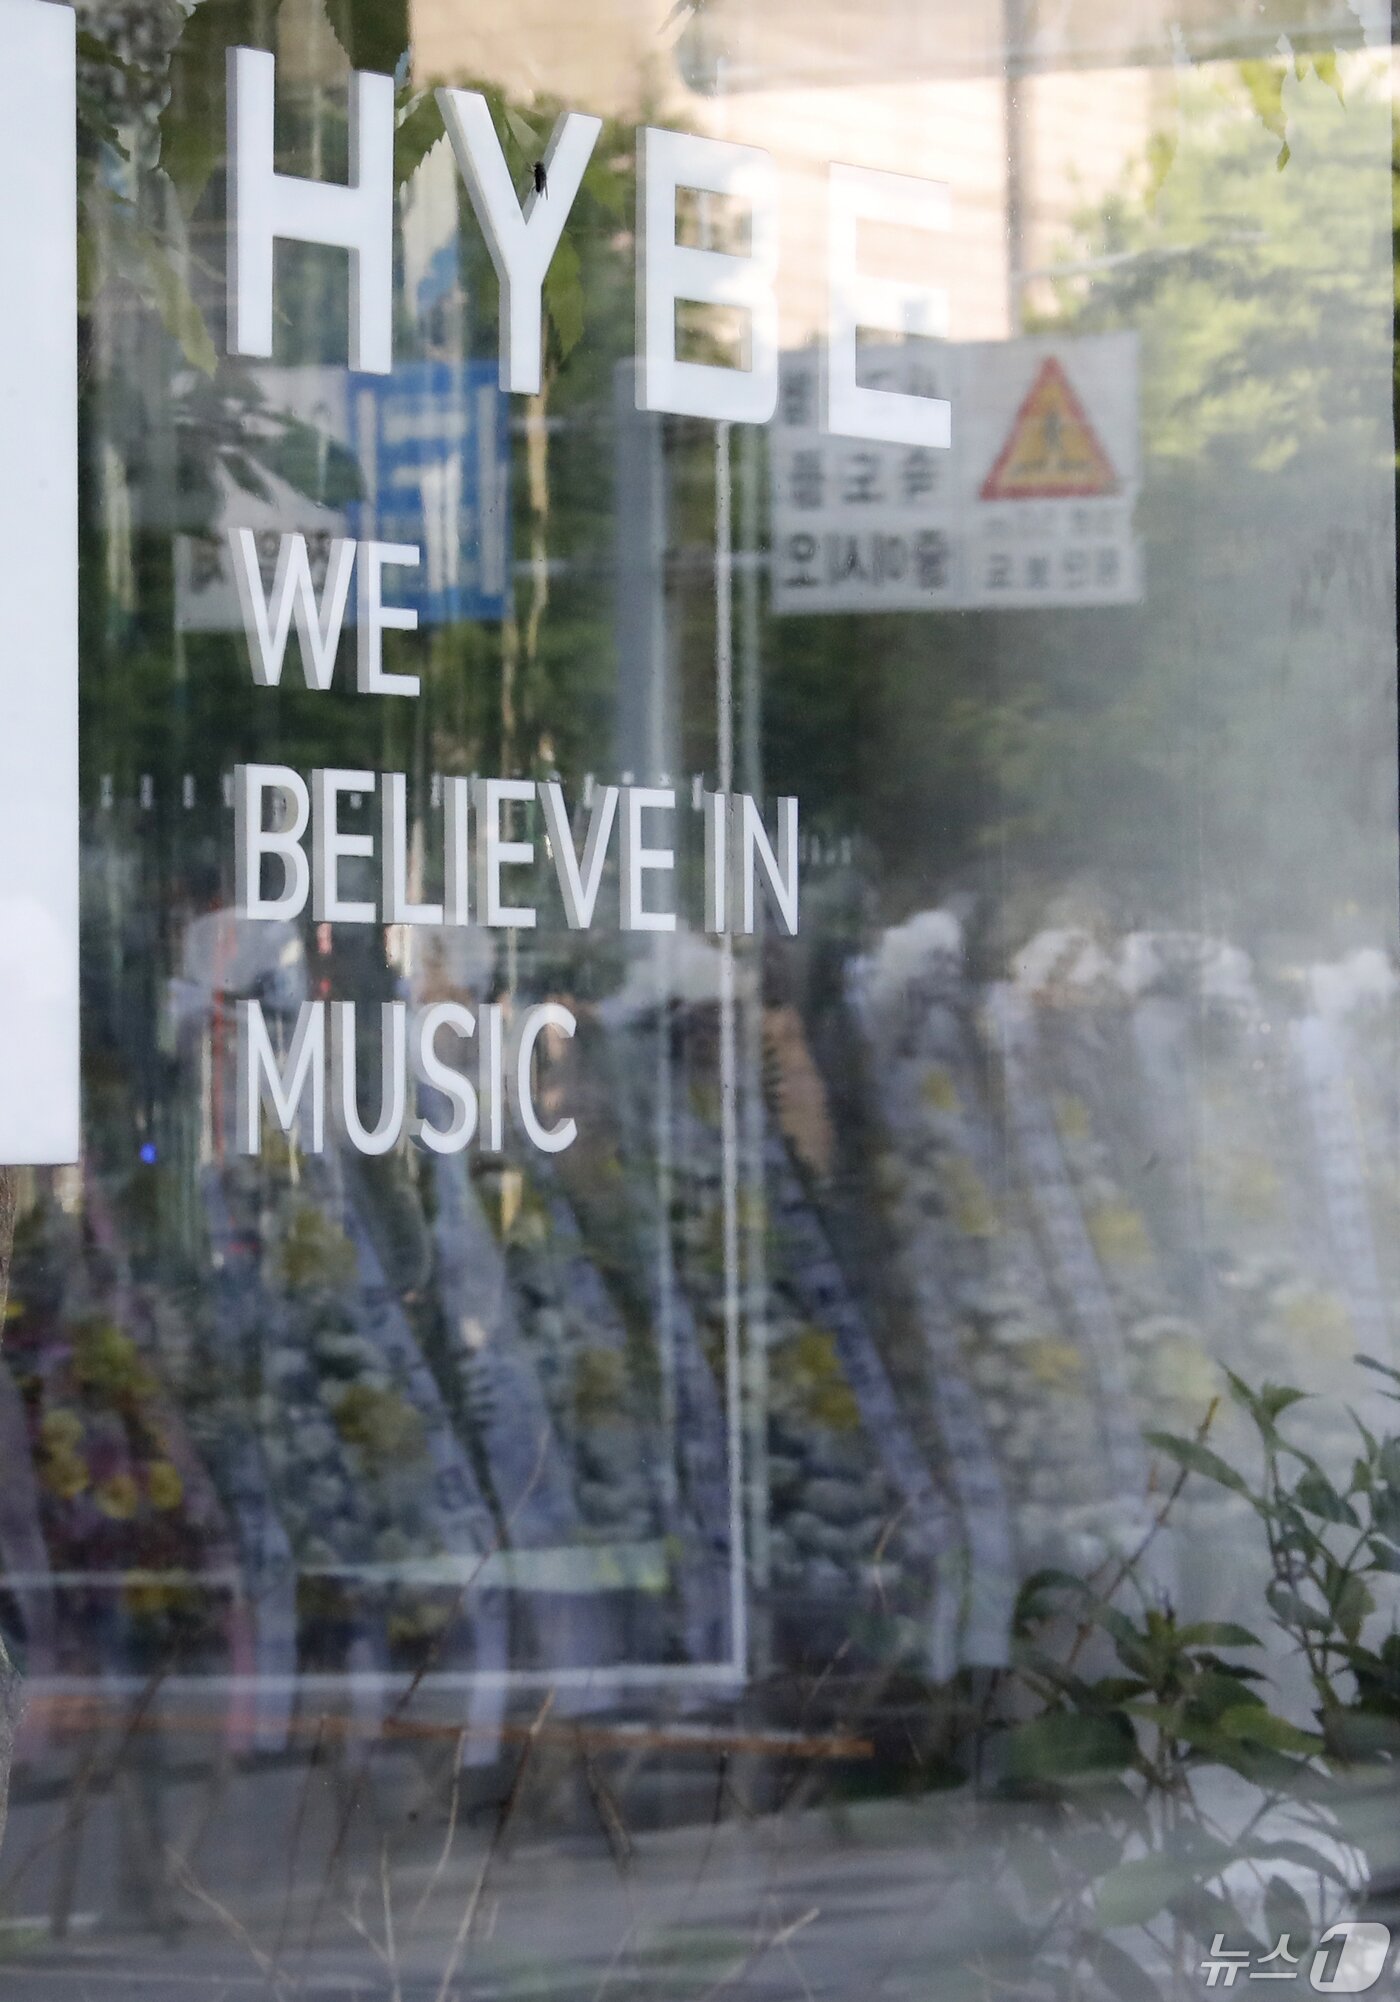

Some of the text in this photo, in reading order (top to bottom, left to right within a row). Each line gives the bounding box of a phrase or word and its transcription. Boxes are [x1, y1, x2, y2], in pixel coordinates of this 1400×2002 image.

[226, 44, 951, 449] HYBE
[228, 527, 420, 697] WE
[234, 763, 799, 936] BELIEVE IN
[236, 1000, 577, 1156] MUSIC
